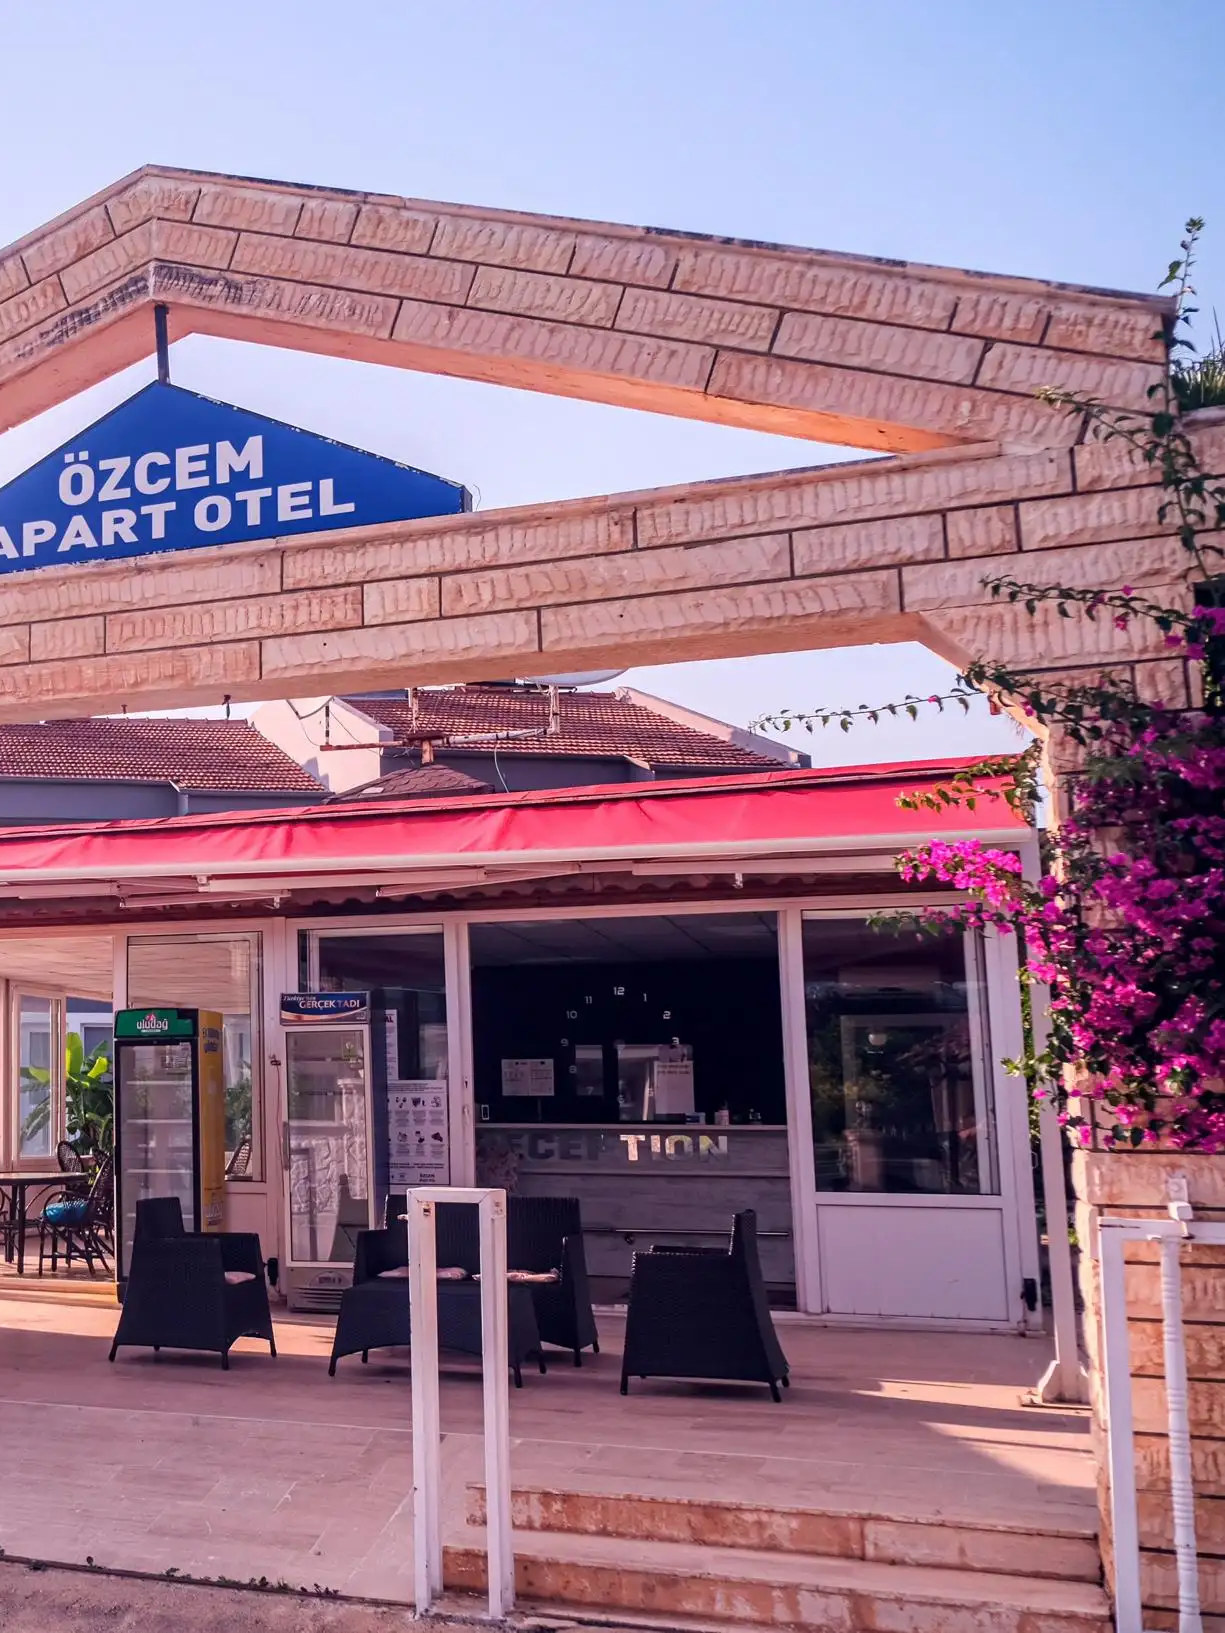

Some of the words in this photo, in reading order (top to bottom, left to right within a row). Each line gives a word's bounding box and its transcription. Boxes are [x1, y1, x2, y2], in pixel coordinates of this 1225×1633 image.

[58, 434, 264, 506] ÖZCEM
[193, 478, 355, 532] OTEL
[613, 986, 625, 995] 12
[298, 999, 336, 1010] GERÇEK
[337, 999, 360, 1008] TADI
[584, 996, 592, 1004] 11
[566, 1010, 577, 1019] 10
[663, 1010, 671, 1019] 2
[560, 1038, 569, 1047] 9
